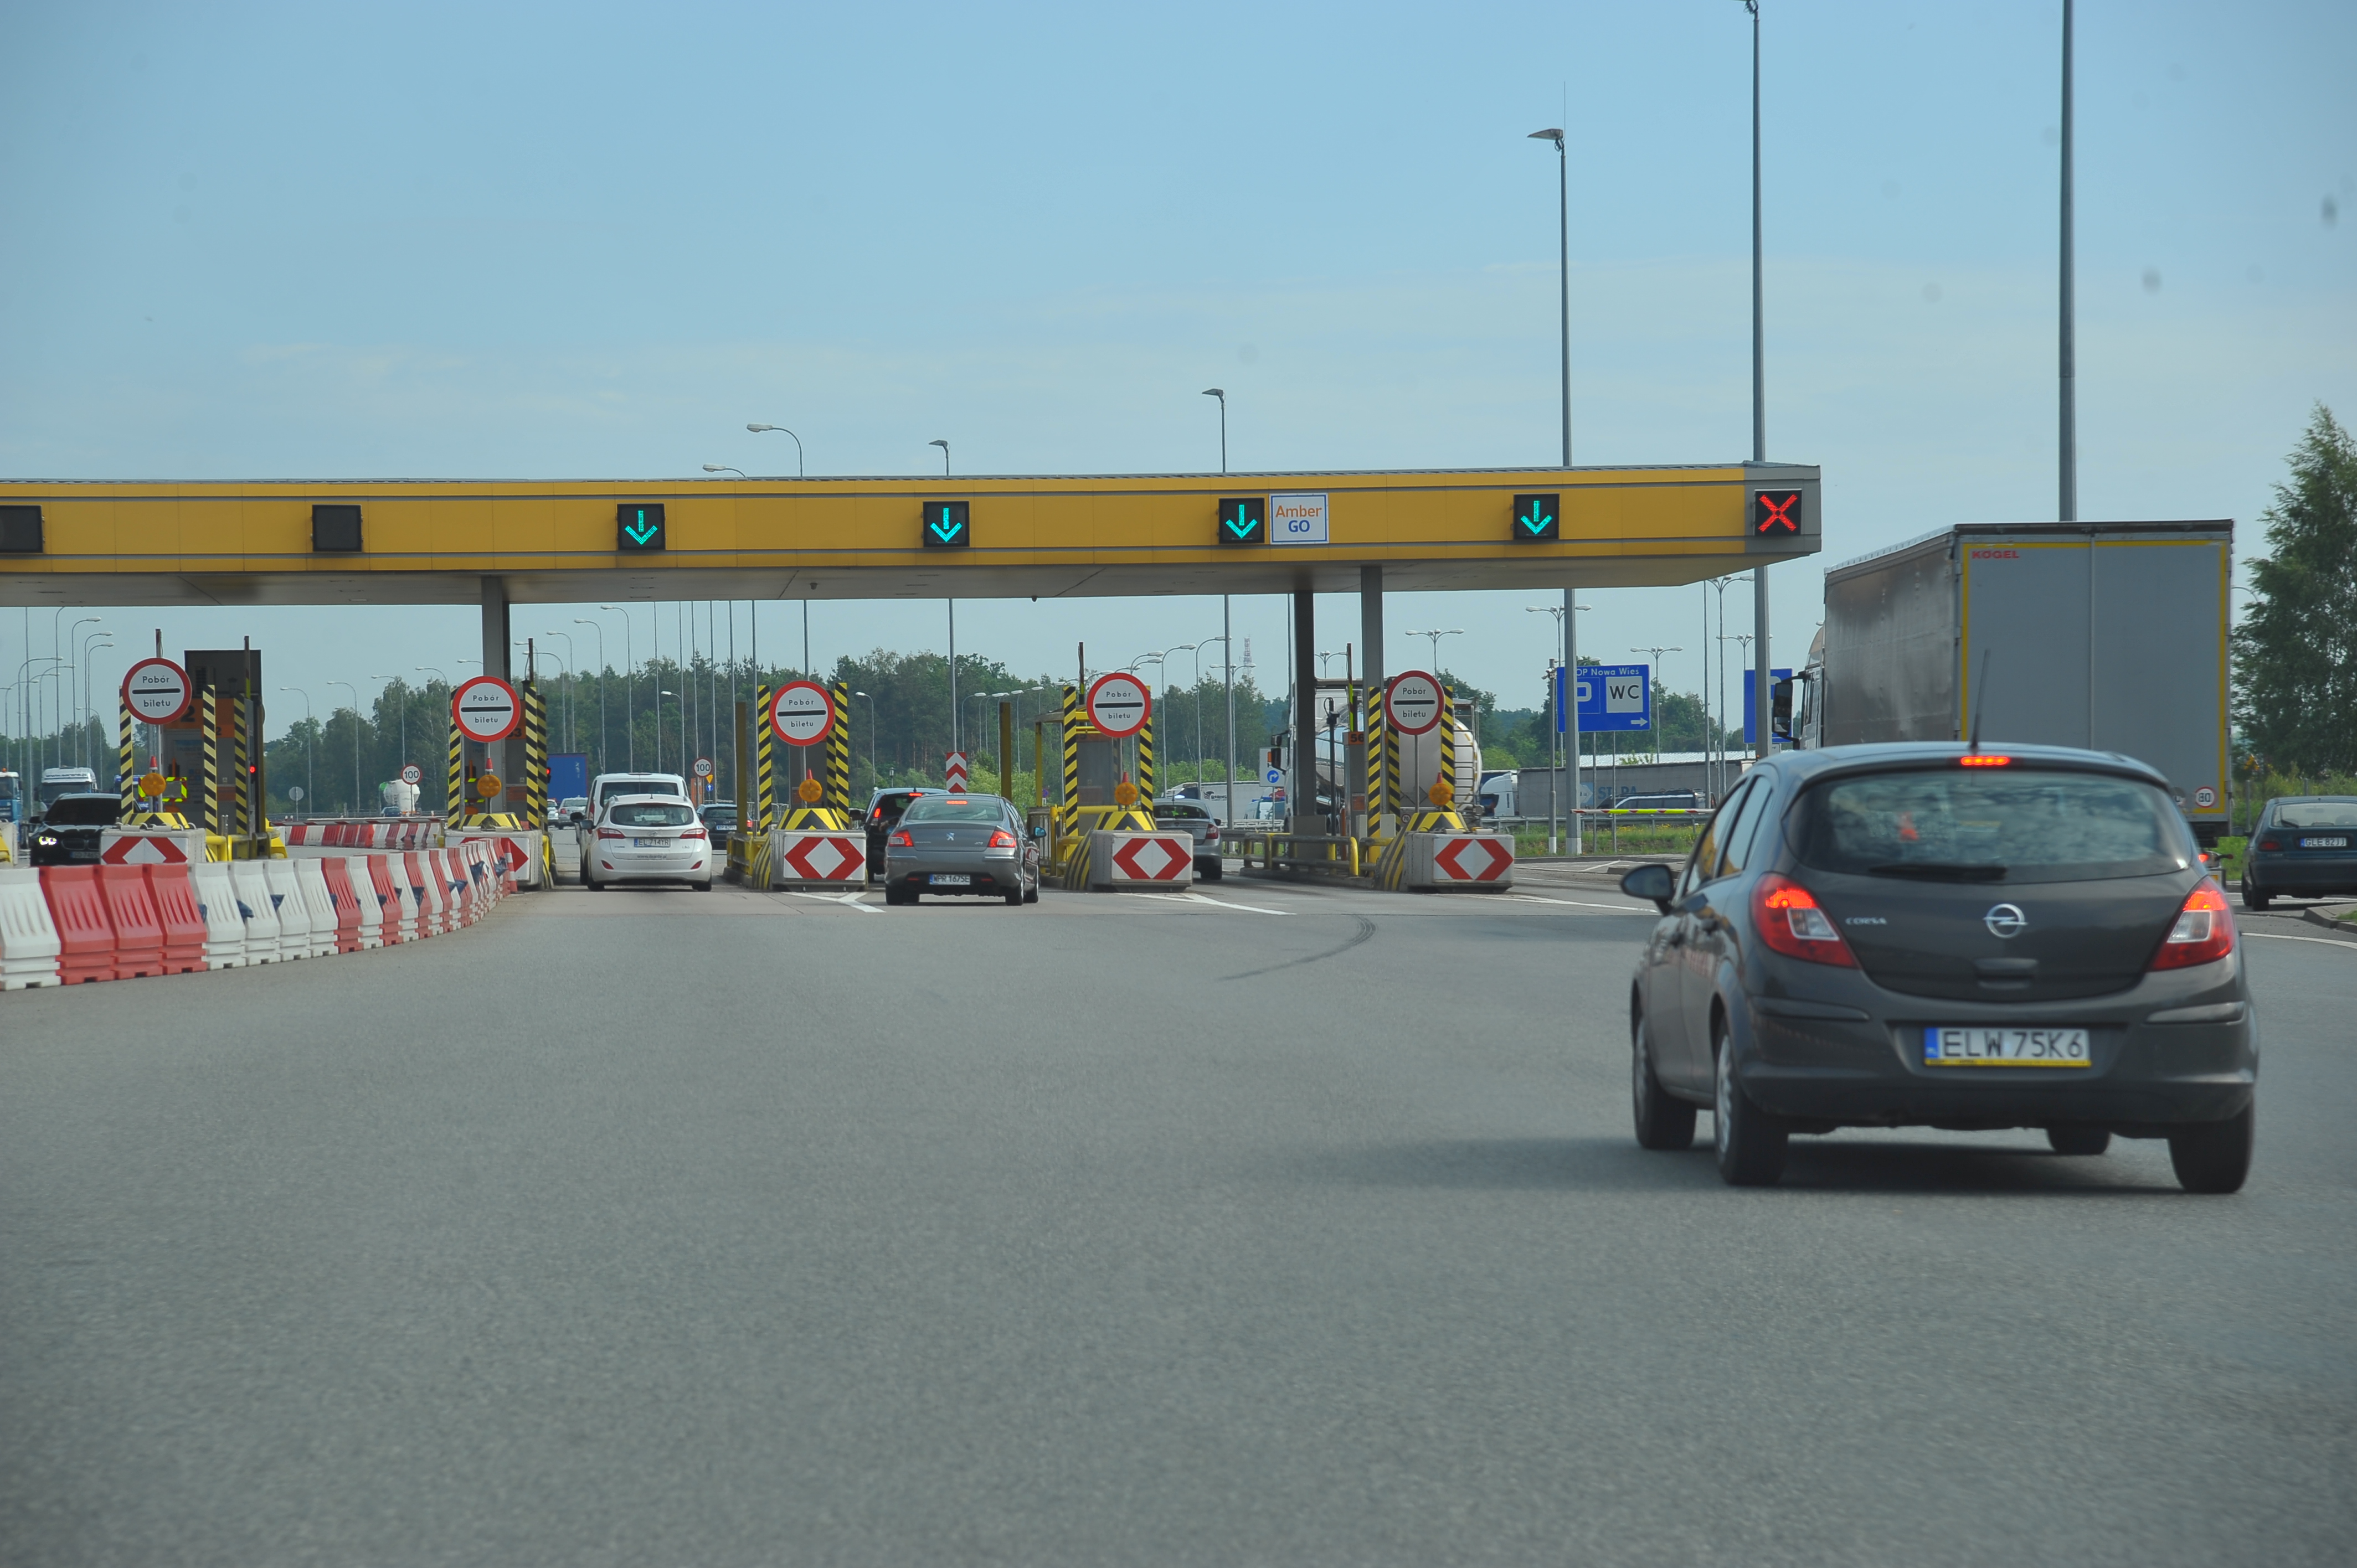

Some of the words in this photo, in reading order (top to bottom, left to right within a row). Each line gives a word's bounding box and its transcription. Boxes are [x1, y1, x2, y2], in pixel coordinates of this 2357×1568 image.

[1275, 504, 1322, 518] Amber
[1288, 519, 1310, 533] GO
[1591, 668, 1616, 676] Nowa
[1619, 667, 1639, 675] Wieś
[142, 675, 169, 684] Pobór
[1609, 684, 1640, 700] WC
[1350, 734, 1364, 742] 56
[696, 764, 711, 772] 100
[404, 770, 419, 779] 100
[2198, 792, 2211, 802] 80
[2305, 838, 2323, 846] GLE
[1943, 1031, 2001, 1058] ELW
[2012, 1031, 2083, 1058] 75K6
